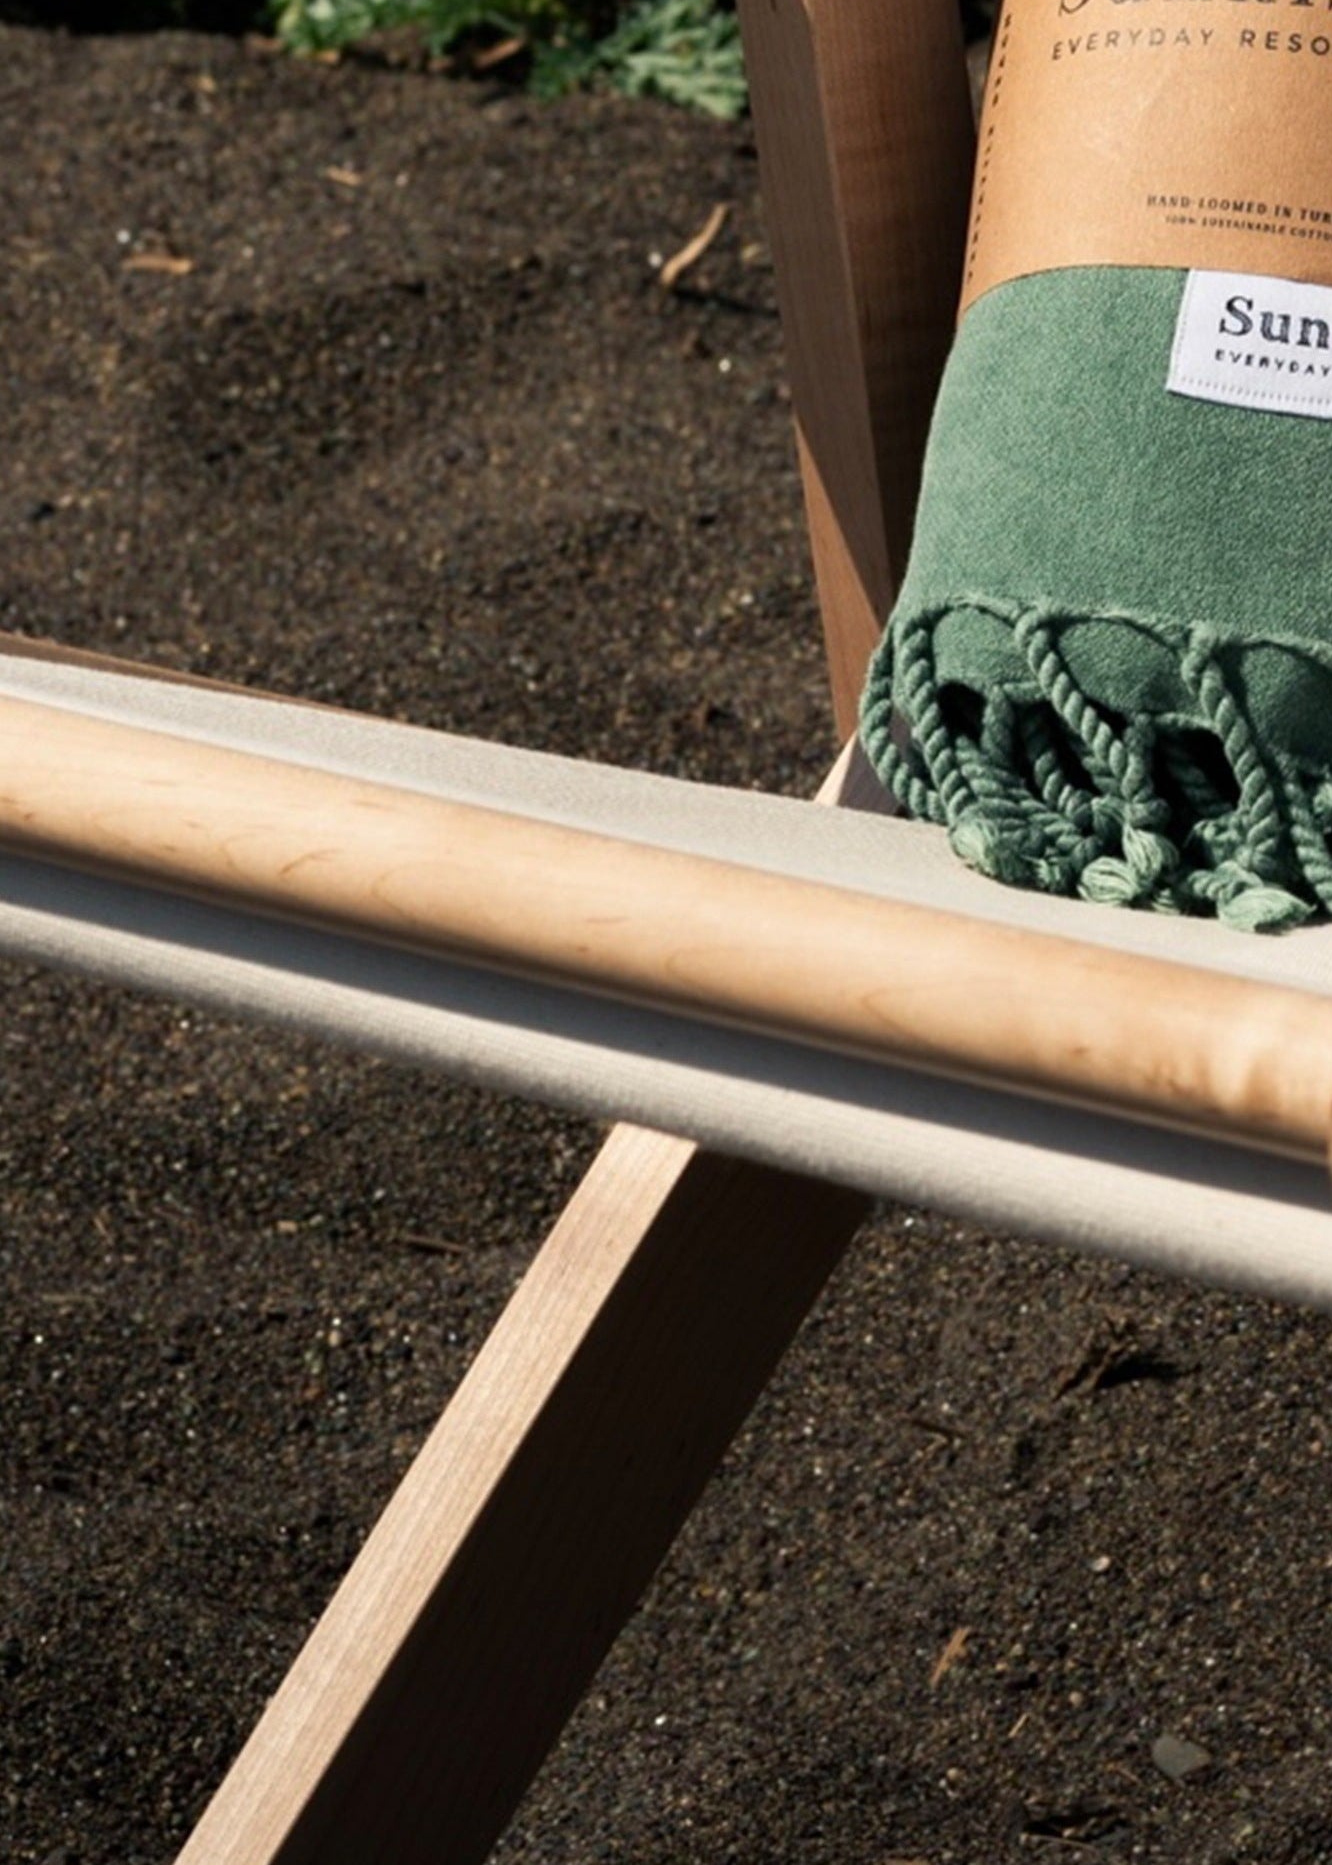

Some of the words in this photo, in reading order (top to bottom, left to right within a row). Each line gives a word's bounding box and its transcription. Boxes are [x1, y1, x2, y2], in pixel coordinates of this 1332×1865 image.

[1052, 28, 1215, 61] EVERYDAY
[1274, 204, 1291, 218] IN
[1215, 348, 1331, 377] EVERYDAY
